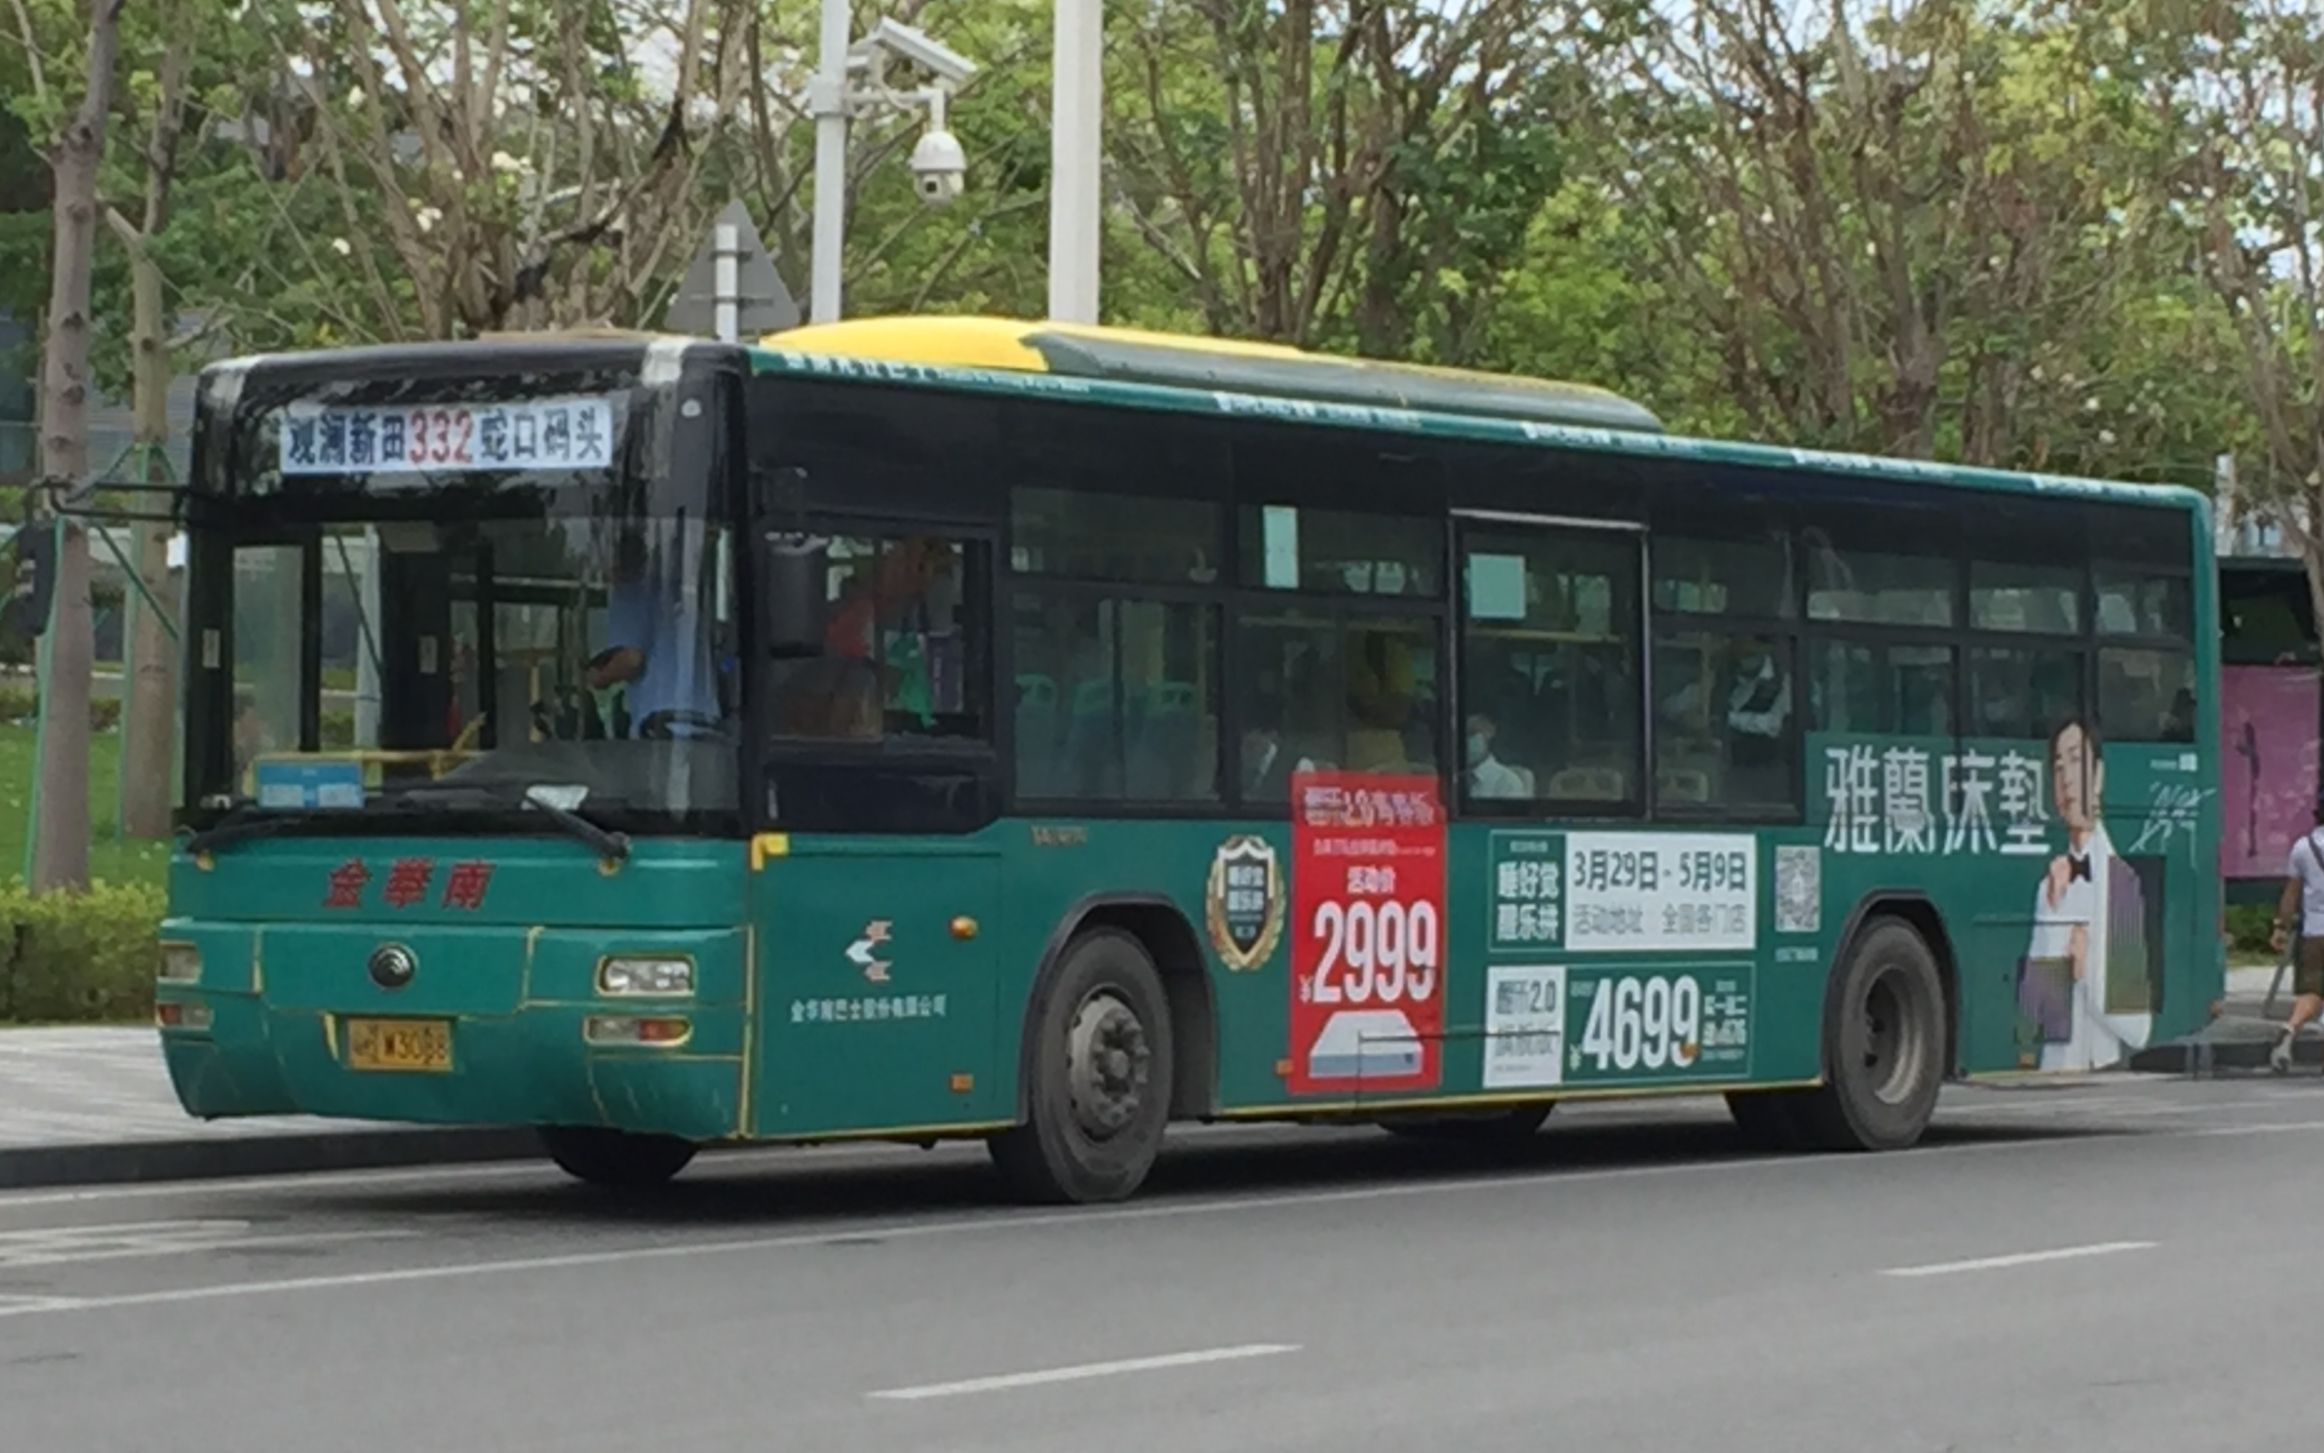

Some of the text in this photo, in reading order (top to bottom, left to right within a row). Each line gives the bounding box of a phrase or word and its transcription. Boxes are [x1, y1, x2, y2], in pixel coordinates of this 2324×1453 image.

[289, 406, 604, 464] 观澜新田 332 蛇口码头
[1825, 744, 2051, 855] 雅蘭床墊
